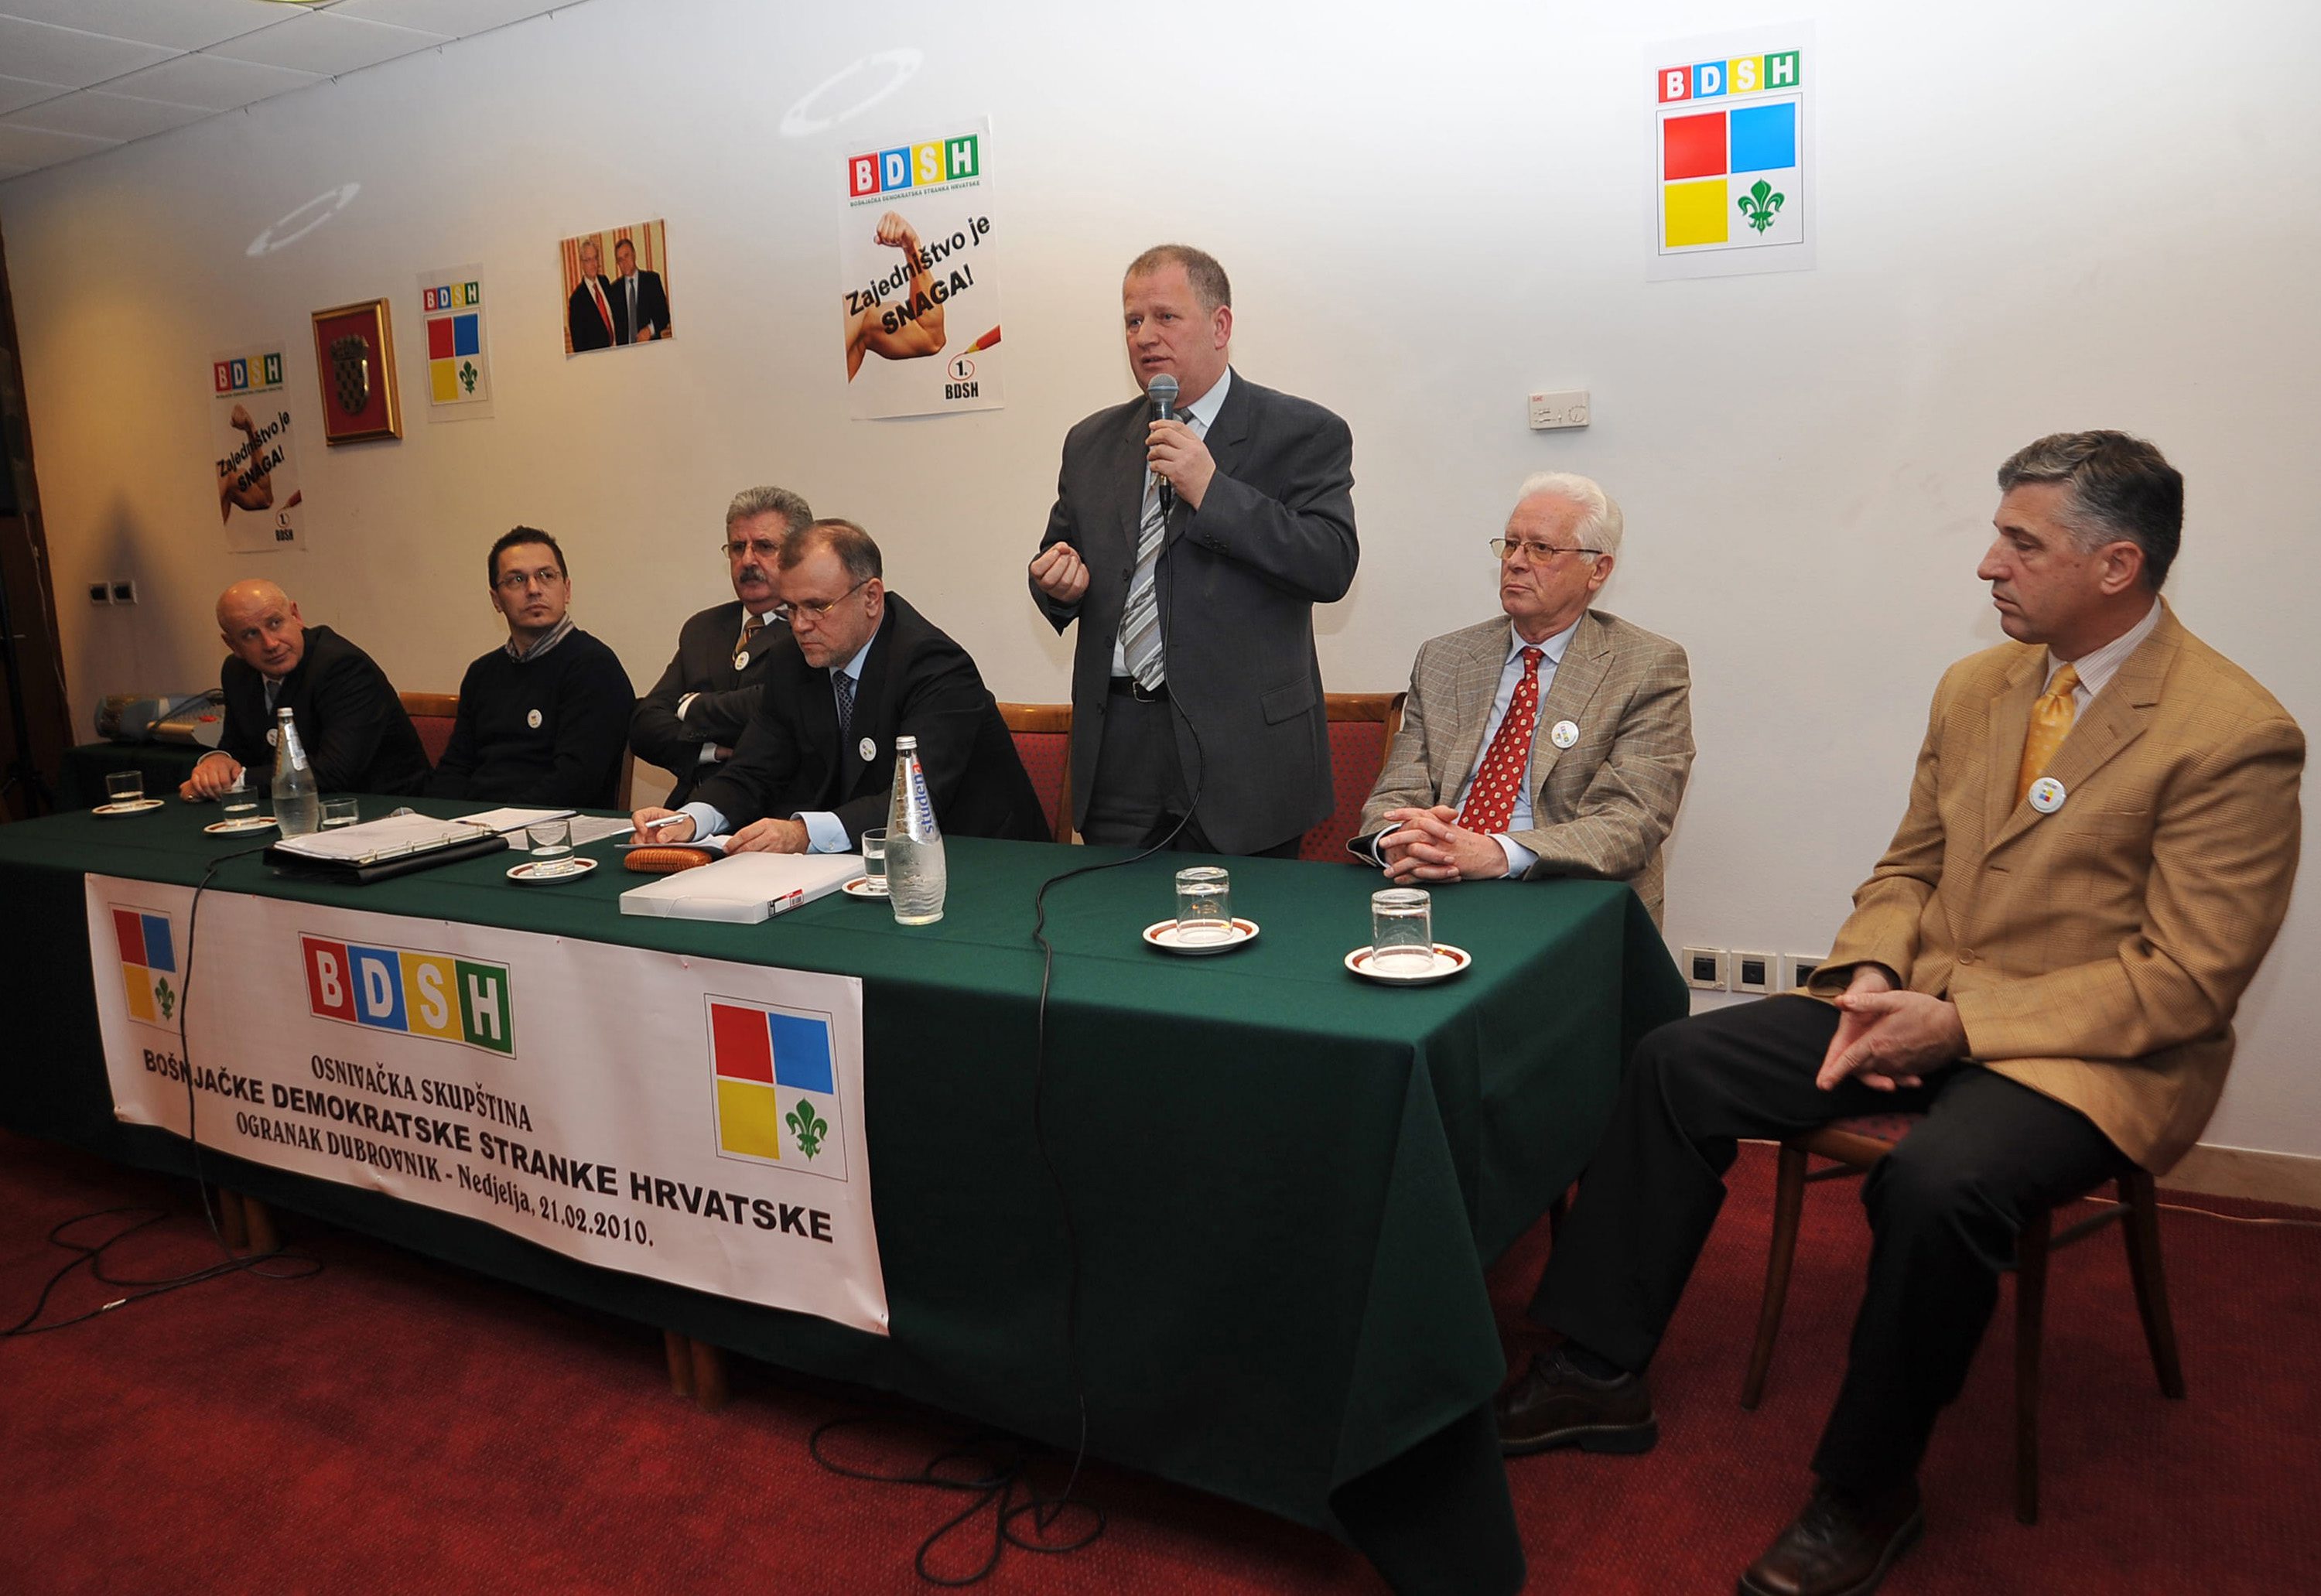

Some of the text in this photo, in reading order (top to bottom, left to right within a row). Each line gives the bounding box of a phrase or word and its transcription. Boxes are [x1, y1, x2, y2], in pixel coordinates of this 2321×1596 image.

[1666, 55, 1795, 100] BDSH
[855, 140, 972, 192] BDSH
[846, 216, 990, 316] Zajedništvo je
[426, 283, 477, 309] BDSH
[881, 263, 974, 335] SNAGA!
[217, 357, 279, 388] BDSH
[945, 381, 979, 399] BDSH
[955, 361, 968, 376] 1.
[279, 411, 290, 432] je
[238, 444, 285, 492] SNAGA!
[314, 949, 502, 1041] BDSH
[311, 1054, 533, 1132] OSNIVAČKA SKUPŠTINA
[236, 1111, 323, 1152] OGRANAK
[326, 1131, 442, 1182] DUBROVNIK
[457, 1164, 535, 1217] Nedjelja,
[539, 1195, 654, 1247] 21.02.2010.
[272, 1084, 472, 1153] DEMOKRATSKE
[479, 1131, 619, 1196] STRANKE
[631, 1171, 834, 1243] HRVATSKE
